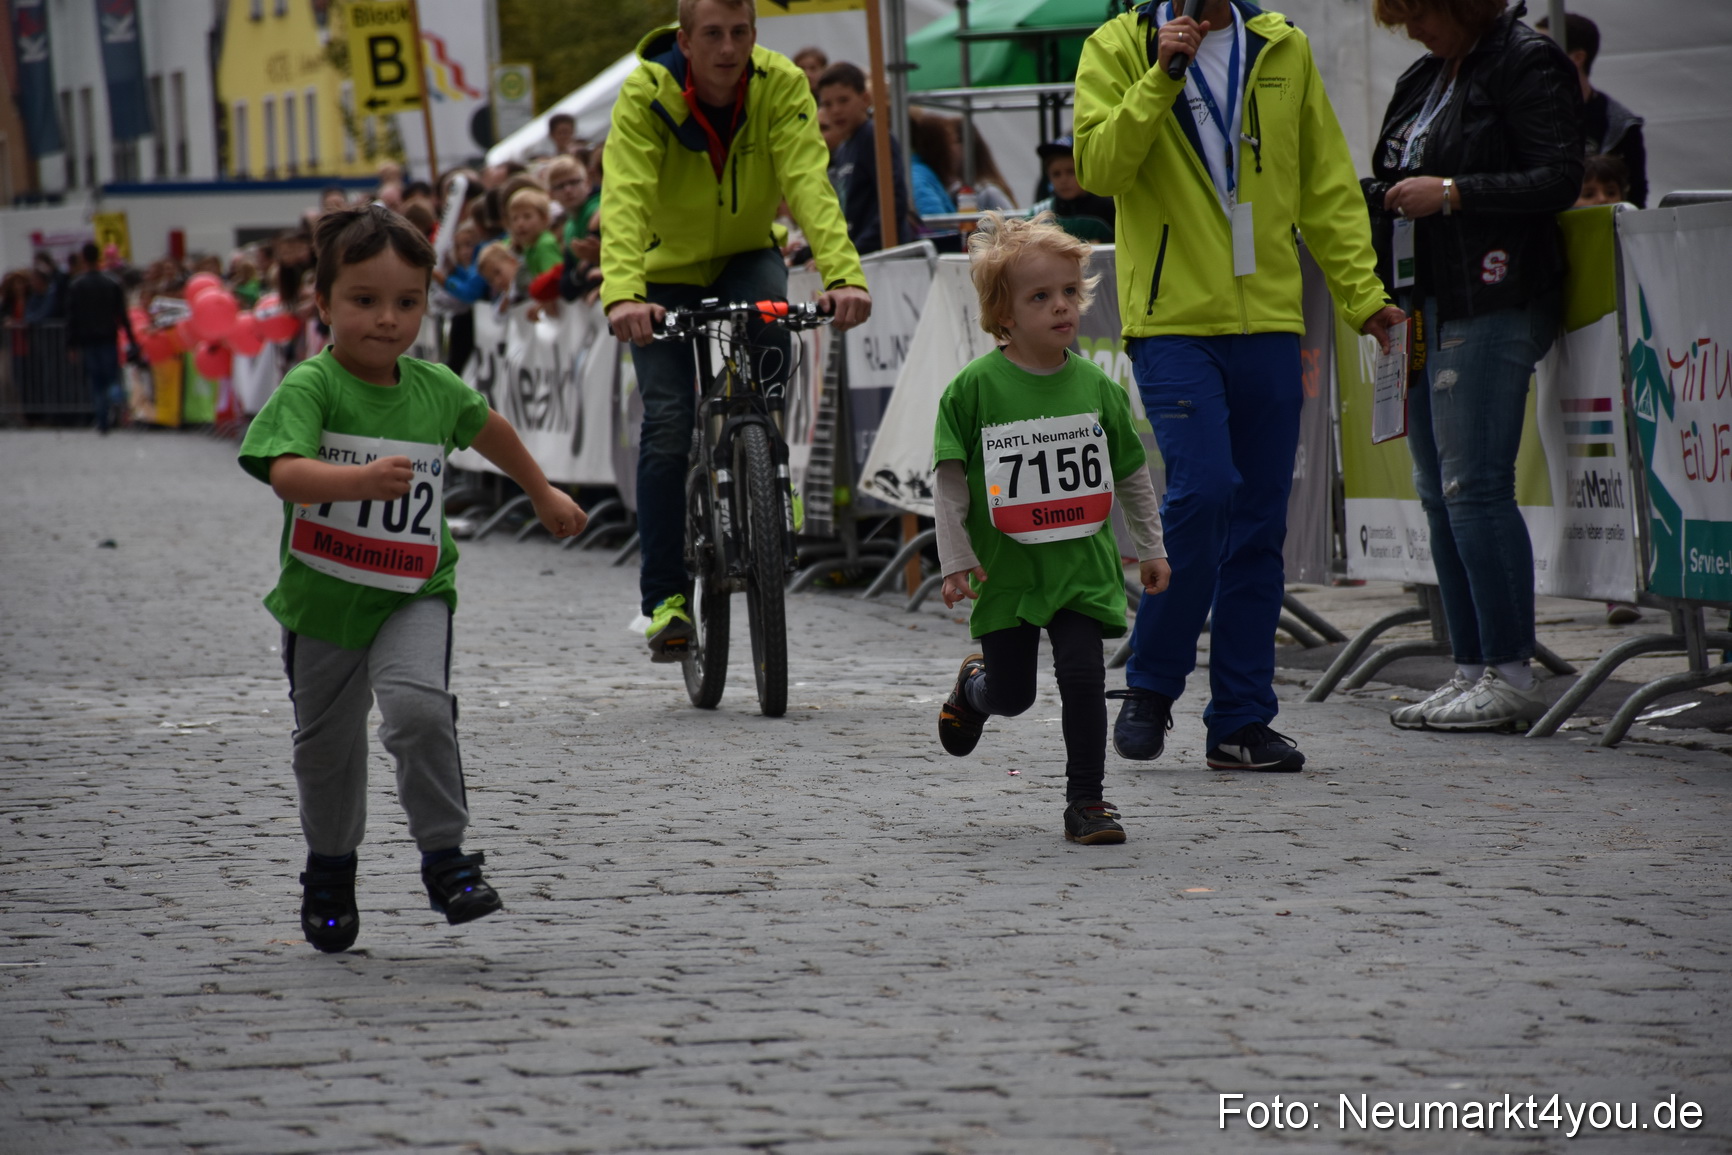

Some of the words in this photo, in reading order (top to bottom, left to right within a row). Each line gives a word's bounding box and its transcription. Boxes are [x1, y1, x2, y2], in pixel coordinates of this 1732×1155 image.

[353, 8, 411, 27] Block
[369, 35, 407, 88] B
[986, 435, 1030, 451] PARTL
[1032, 427, 1090, 445] Neumarkt
[318, 446, 361, 465] ARTL
[999, 443, 1102, 499] 7156
[1103, 482, 1110, 491] K
[994, 497, 1001, 506] 2
[1032, 506, 1085, 527] Simon
[313, 530, 424, 573] Maximilian
